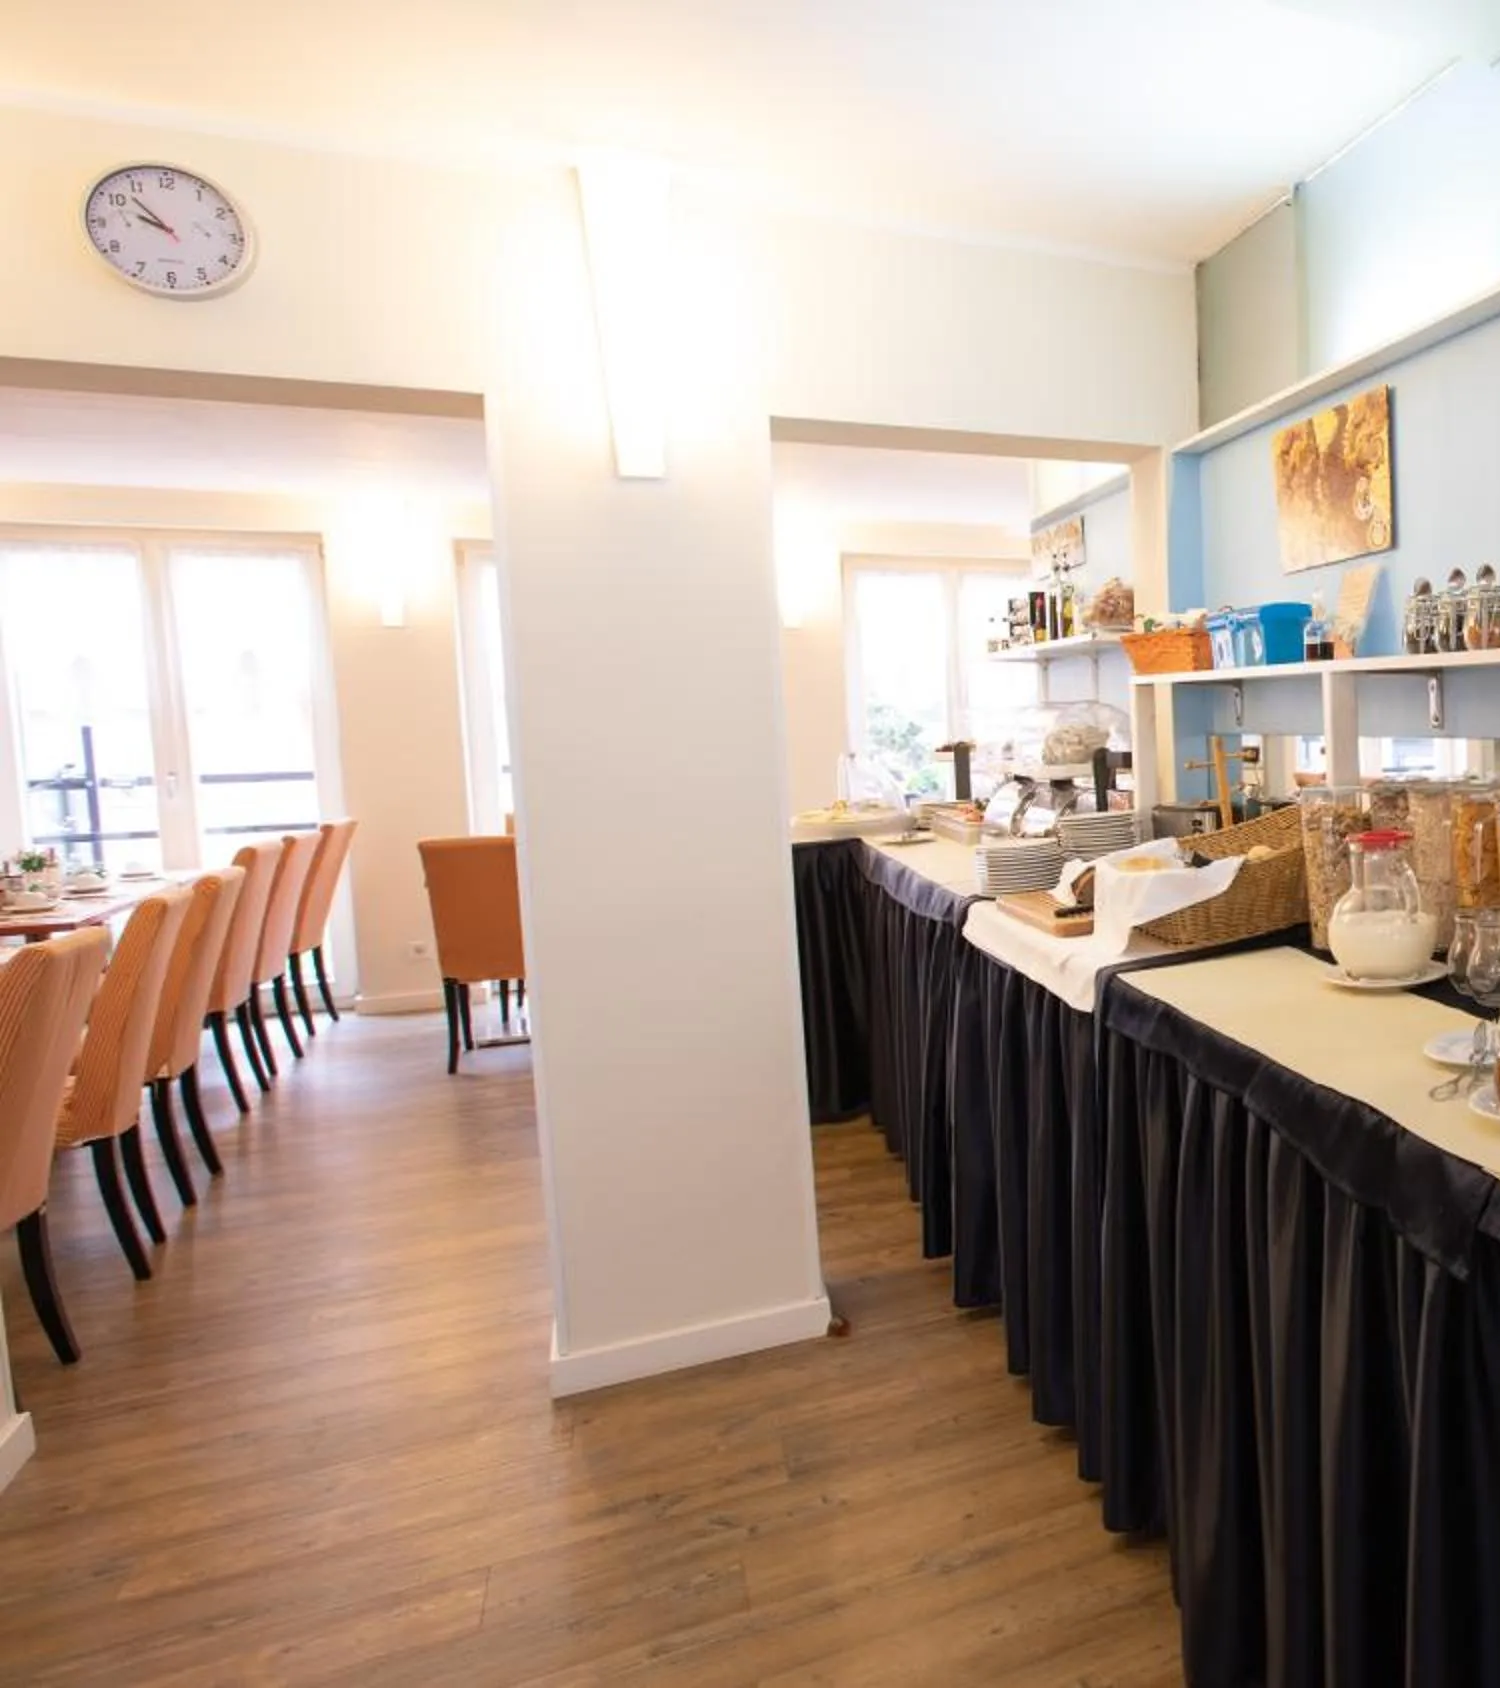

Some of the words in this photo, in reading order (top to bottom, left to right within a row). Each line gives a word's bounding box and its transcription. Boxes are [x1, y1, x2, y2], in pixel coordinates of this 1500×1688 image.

[130, 180, 143, 193] 11
[159, 177, 175, 191] 12
[108, 193, 126, 207] 10
[196, 189, 202, 202] 1
[215, 207, 226, 220] 2
[228, 233, 239, 245] 3
[109, 240, 120, 253] 8
[218, 254, 229, 266] 4
[135, 261, 147, 274] 7
[197, 267, 207, 281] 5
[166, 271, 177, 286] 6
